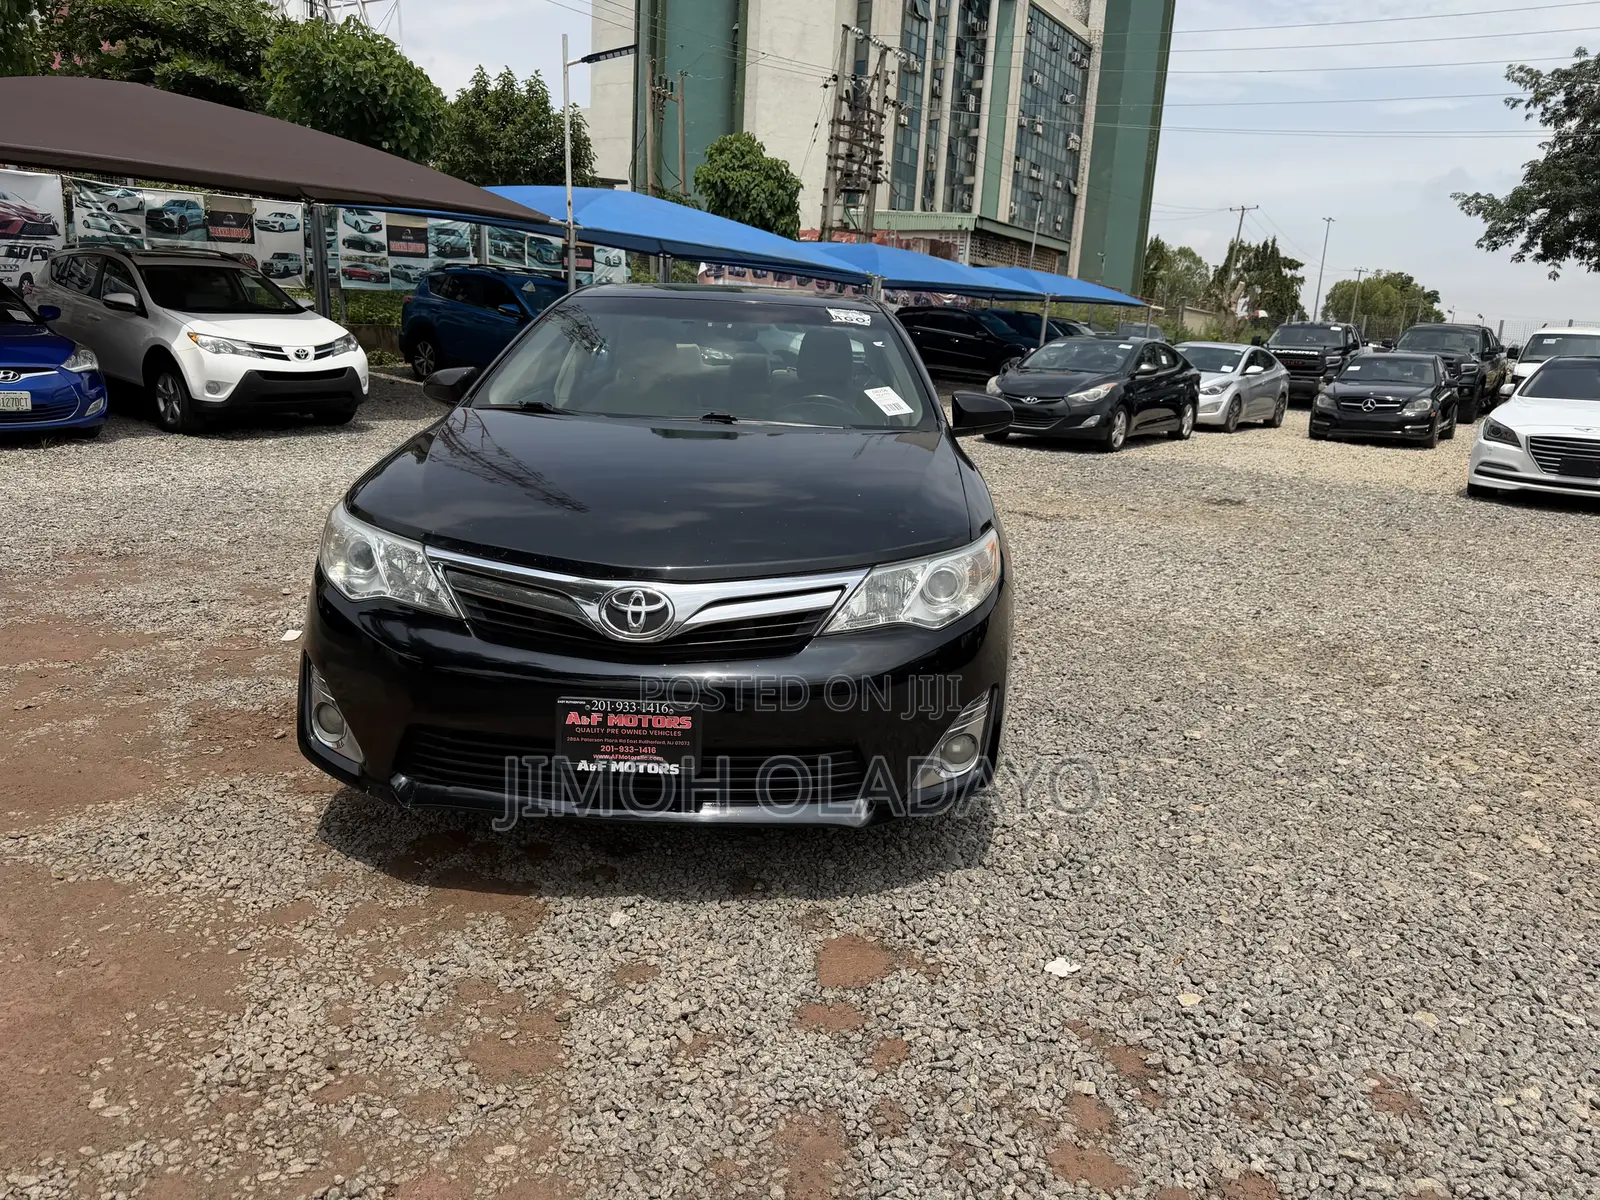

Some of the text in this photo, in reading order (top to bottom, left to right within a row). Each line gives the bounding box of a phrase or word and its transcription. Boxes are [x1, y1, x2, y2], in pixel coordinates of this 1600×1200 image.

[0, 397, 28, 407] 127DCT
[565, 711, 692, 729] A&F MOTORS
[600, 745, 657, 754] 201-933-1416
[577, 759, 680, 775] A&F MOTORS
